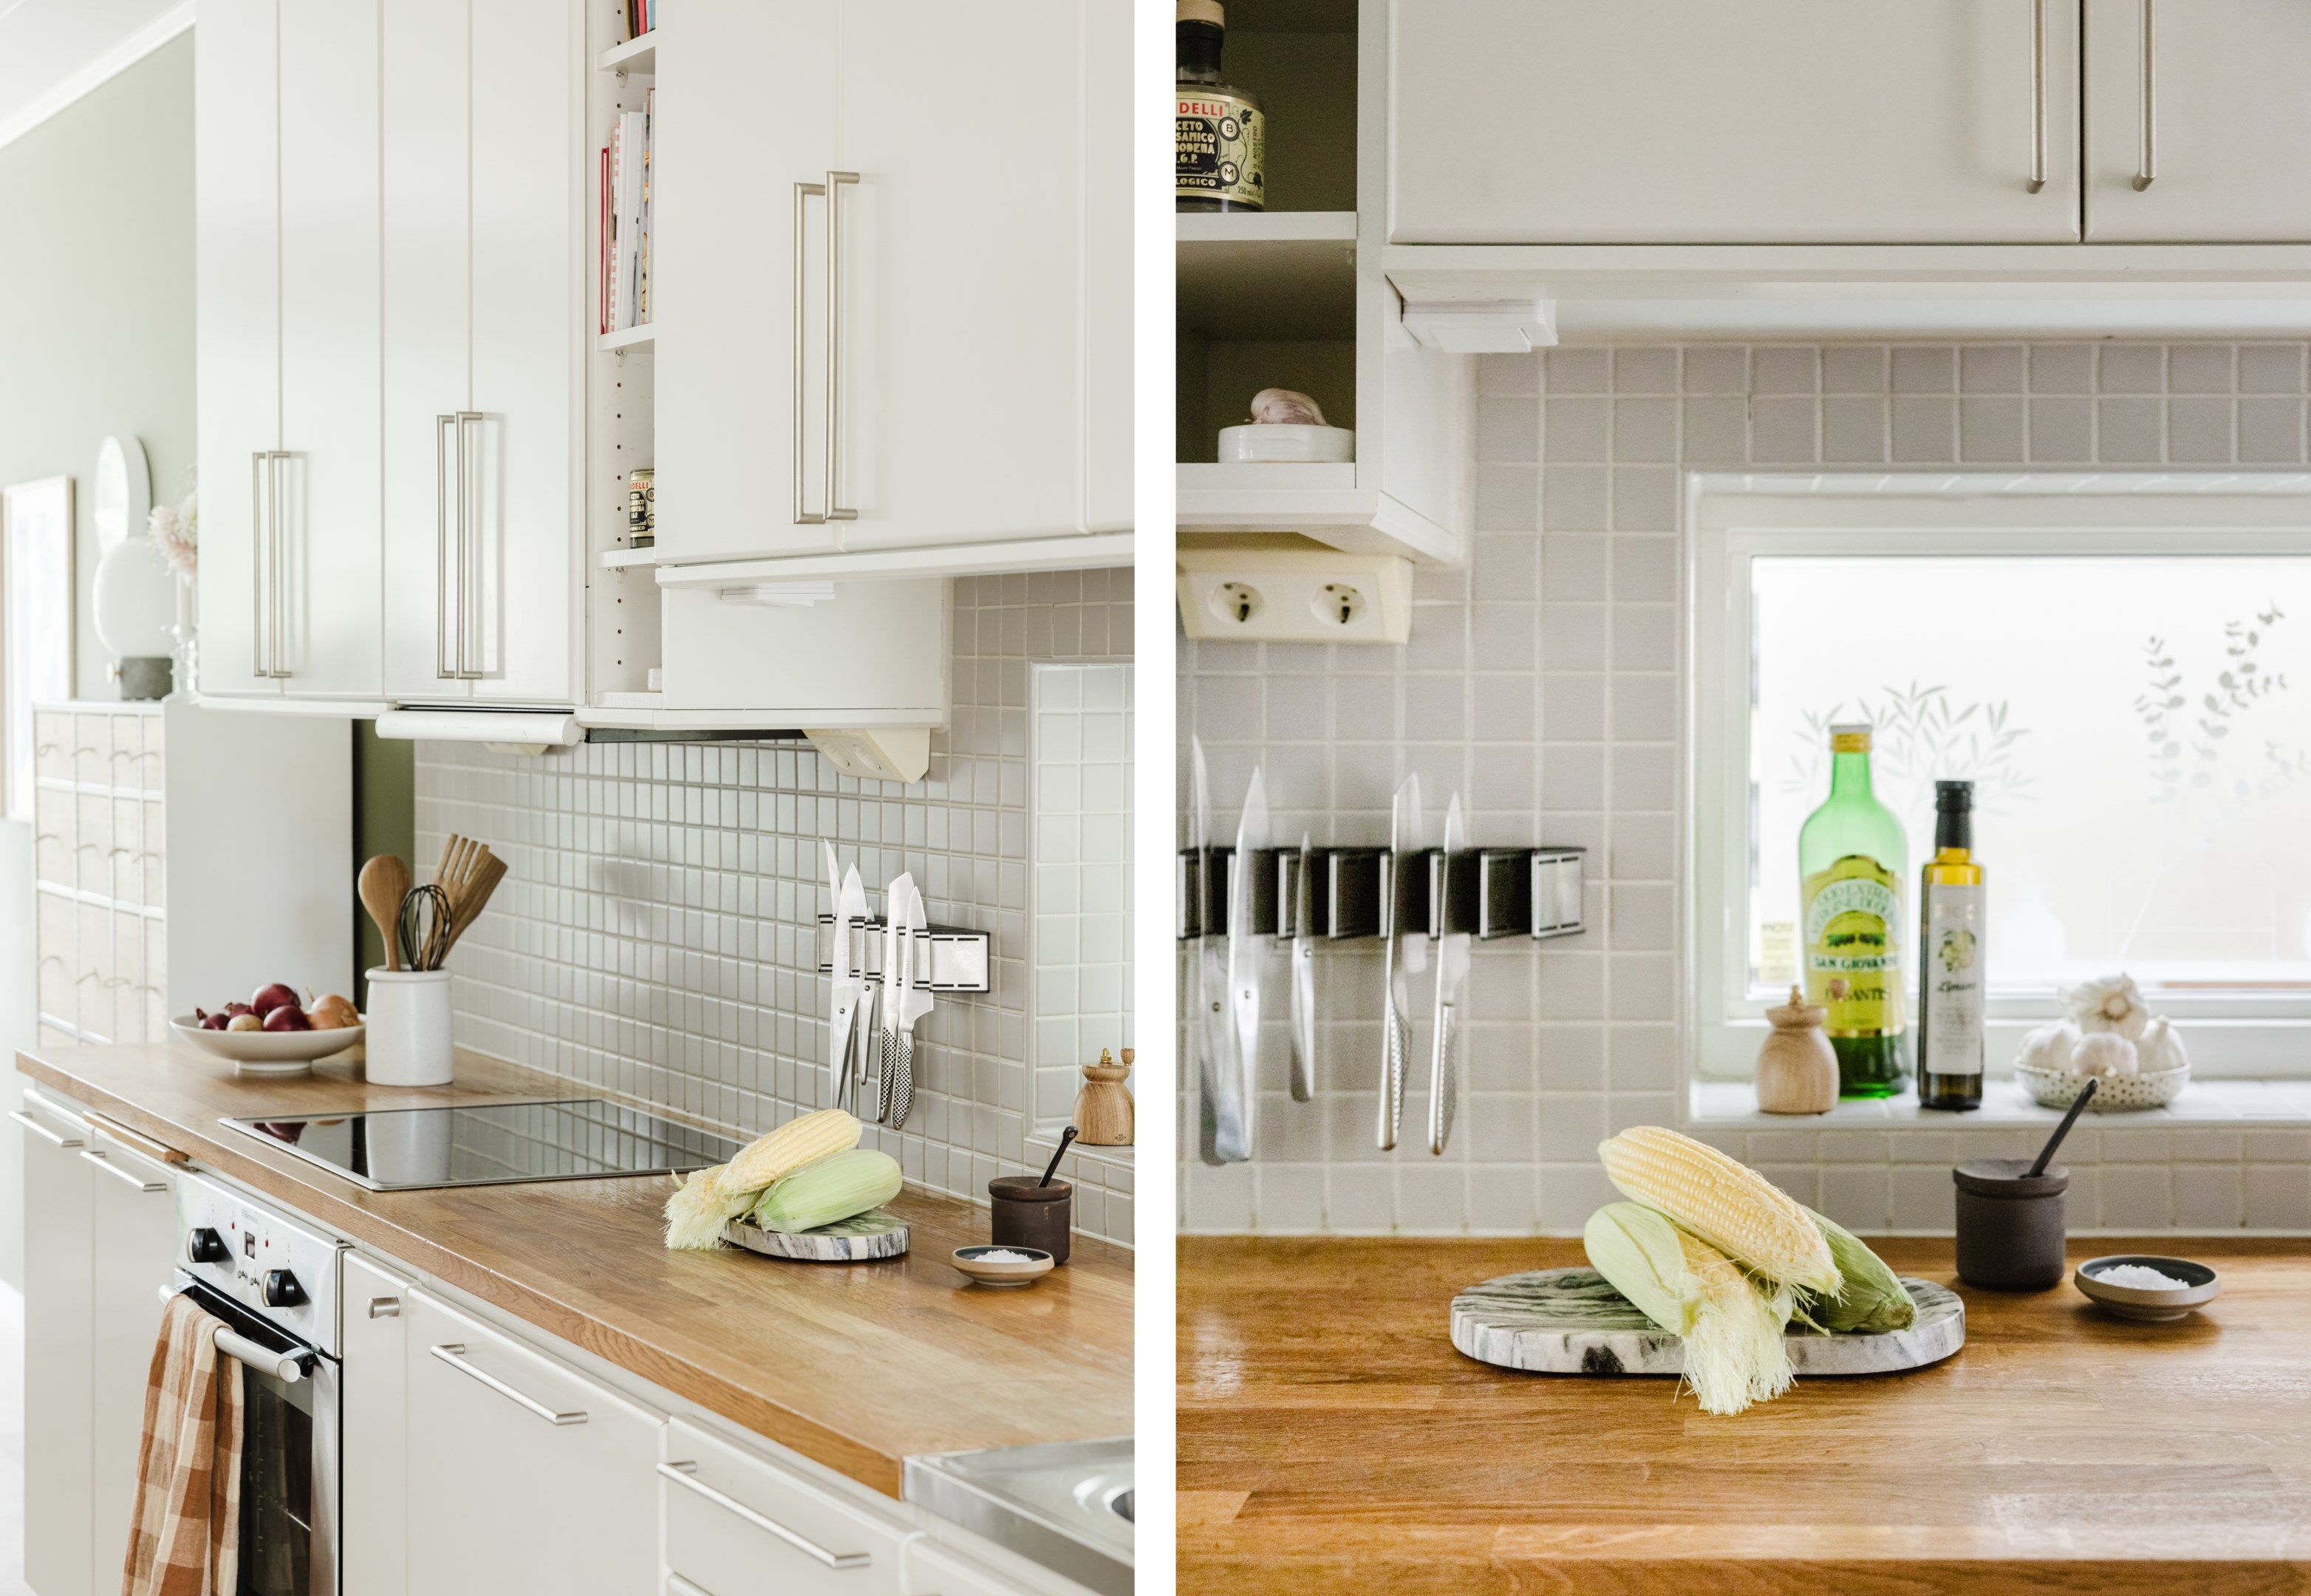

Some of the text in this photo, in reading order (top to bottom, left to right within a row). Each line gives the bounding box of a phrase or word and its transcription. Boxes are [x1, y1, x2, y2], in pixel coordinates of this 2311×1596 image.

[1176, 102, 1223, 117] DELLI
[1176, 120, 1204, 131] CETO
[1226, 123, 1234, 133] B
[1224, 167, 1234, 177] M
[1238, 185, 1247, 195] 250
